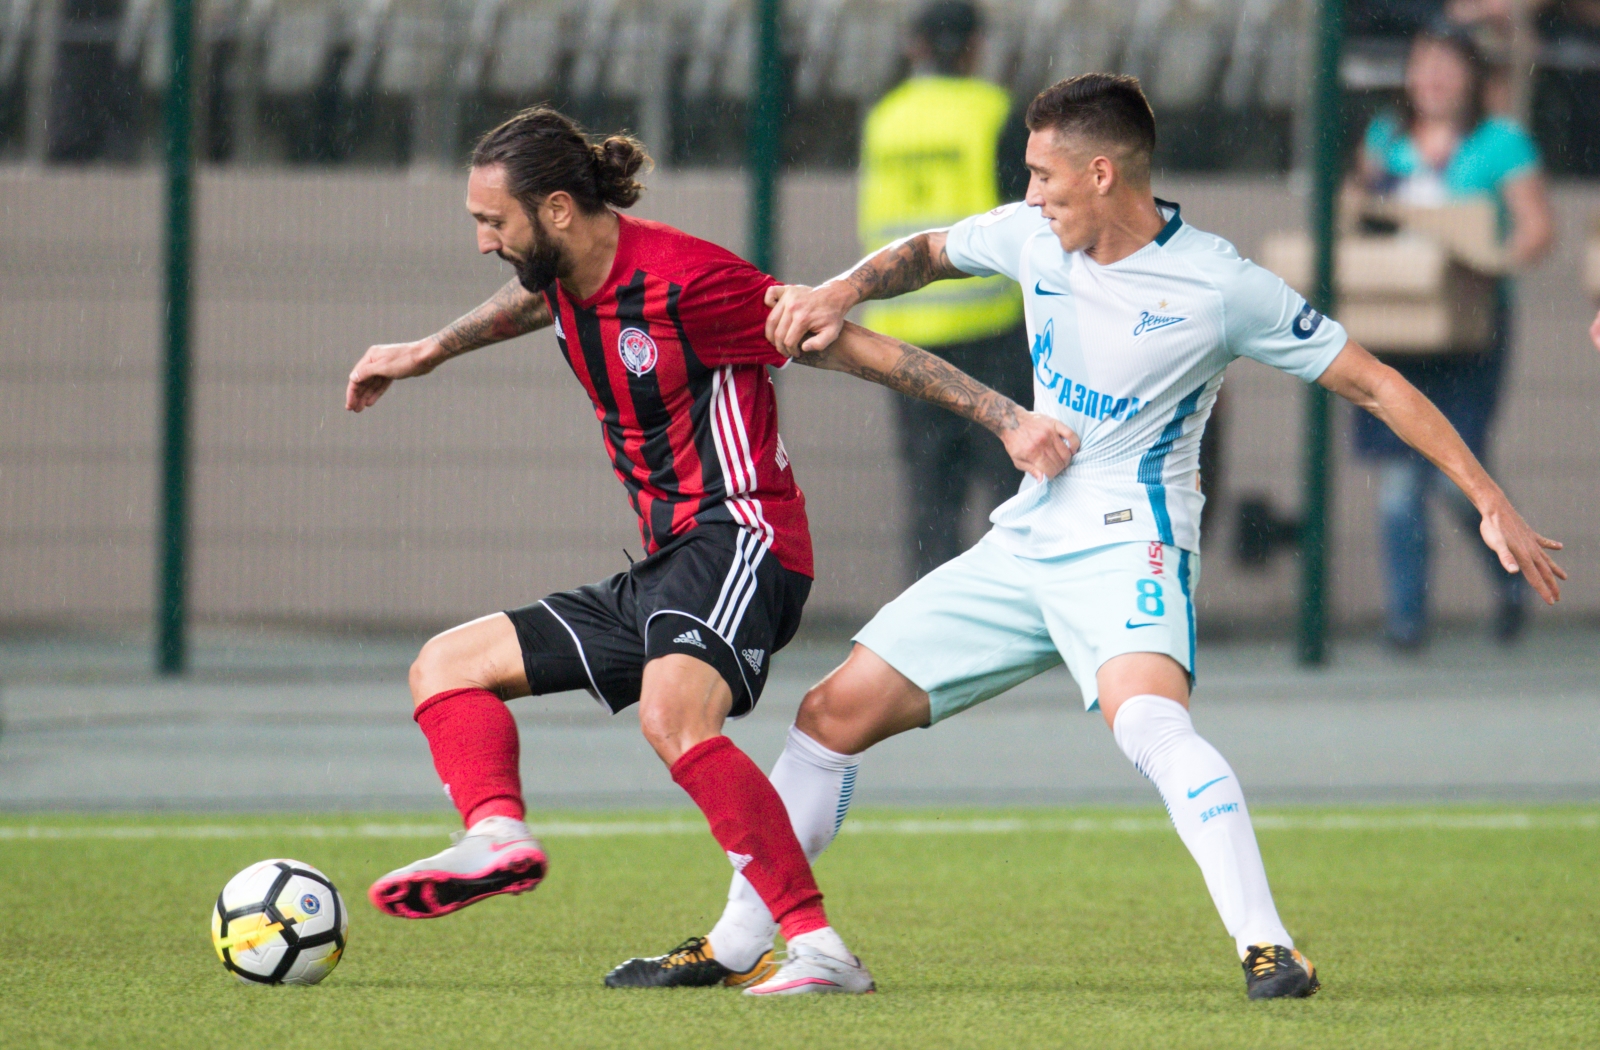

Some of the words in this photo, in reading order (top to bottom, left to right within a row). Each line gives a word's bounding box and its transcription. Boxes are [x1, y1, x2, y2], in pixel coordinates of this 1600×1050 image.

[1136, 579, 1165, 617] 8
[673, 637, 707, 650] adidas
[742, 649, 761, 676] adidas
[1199, 802, 1239, 823] ЗЕНИТ
